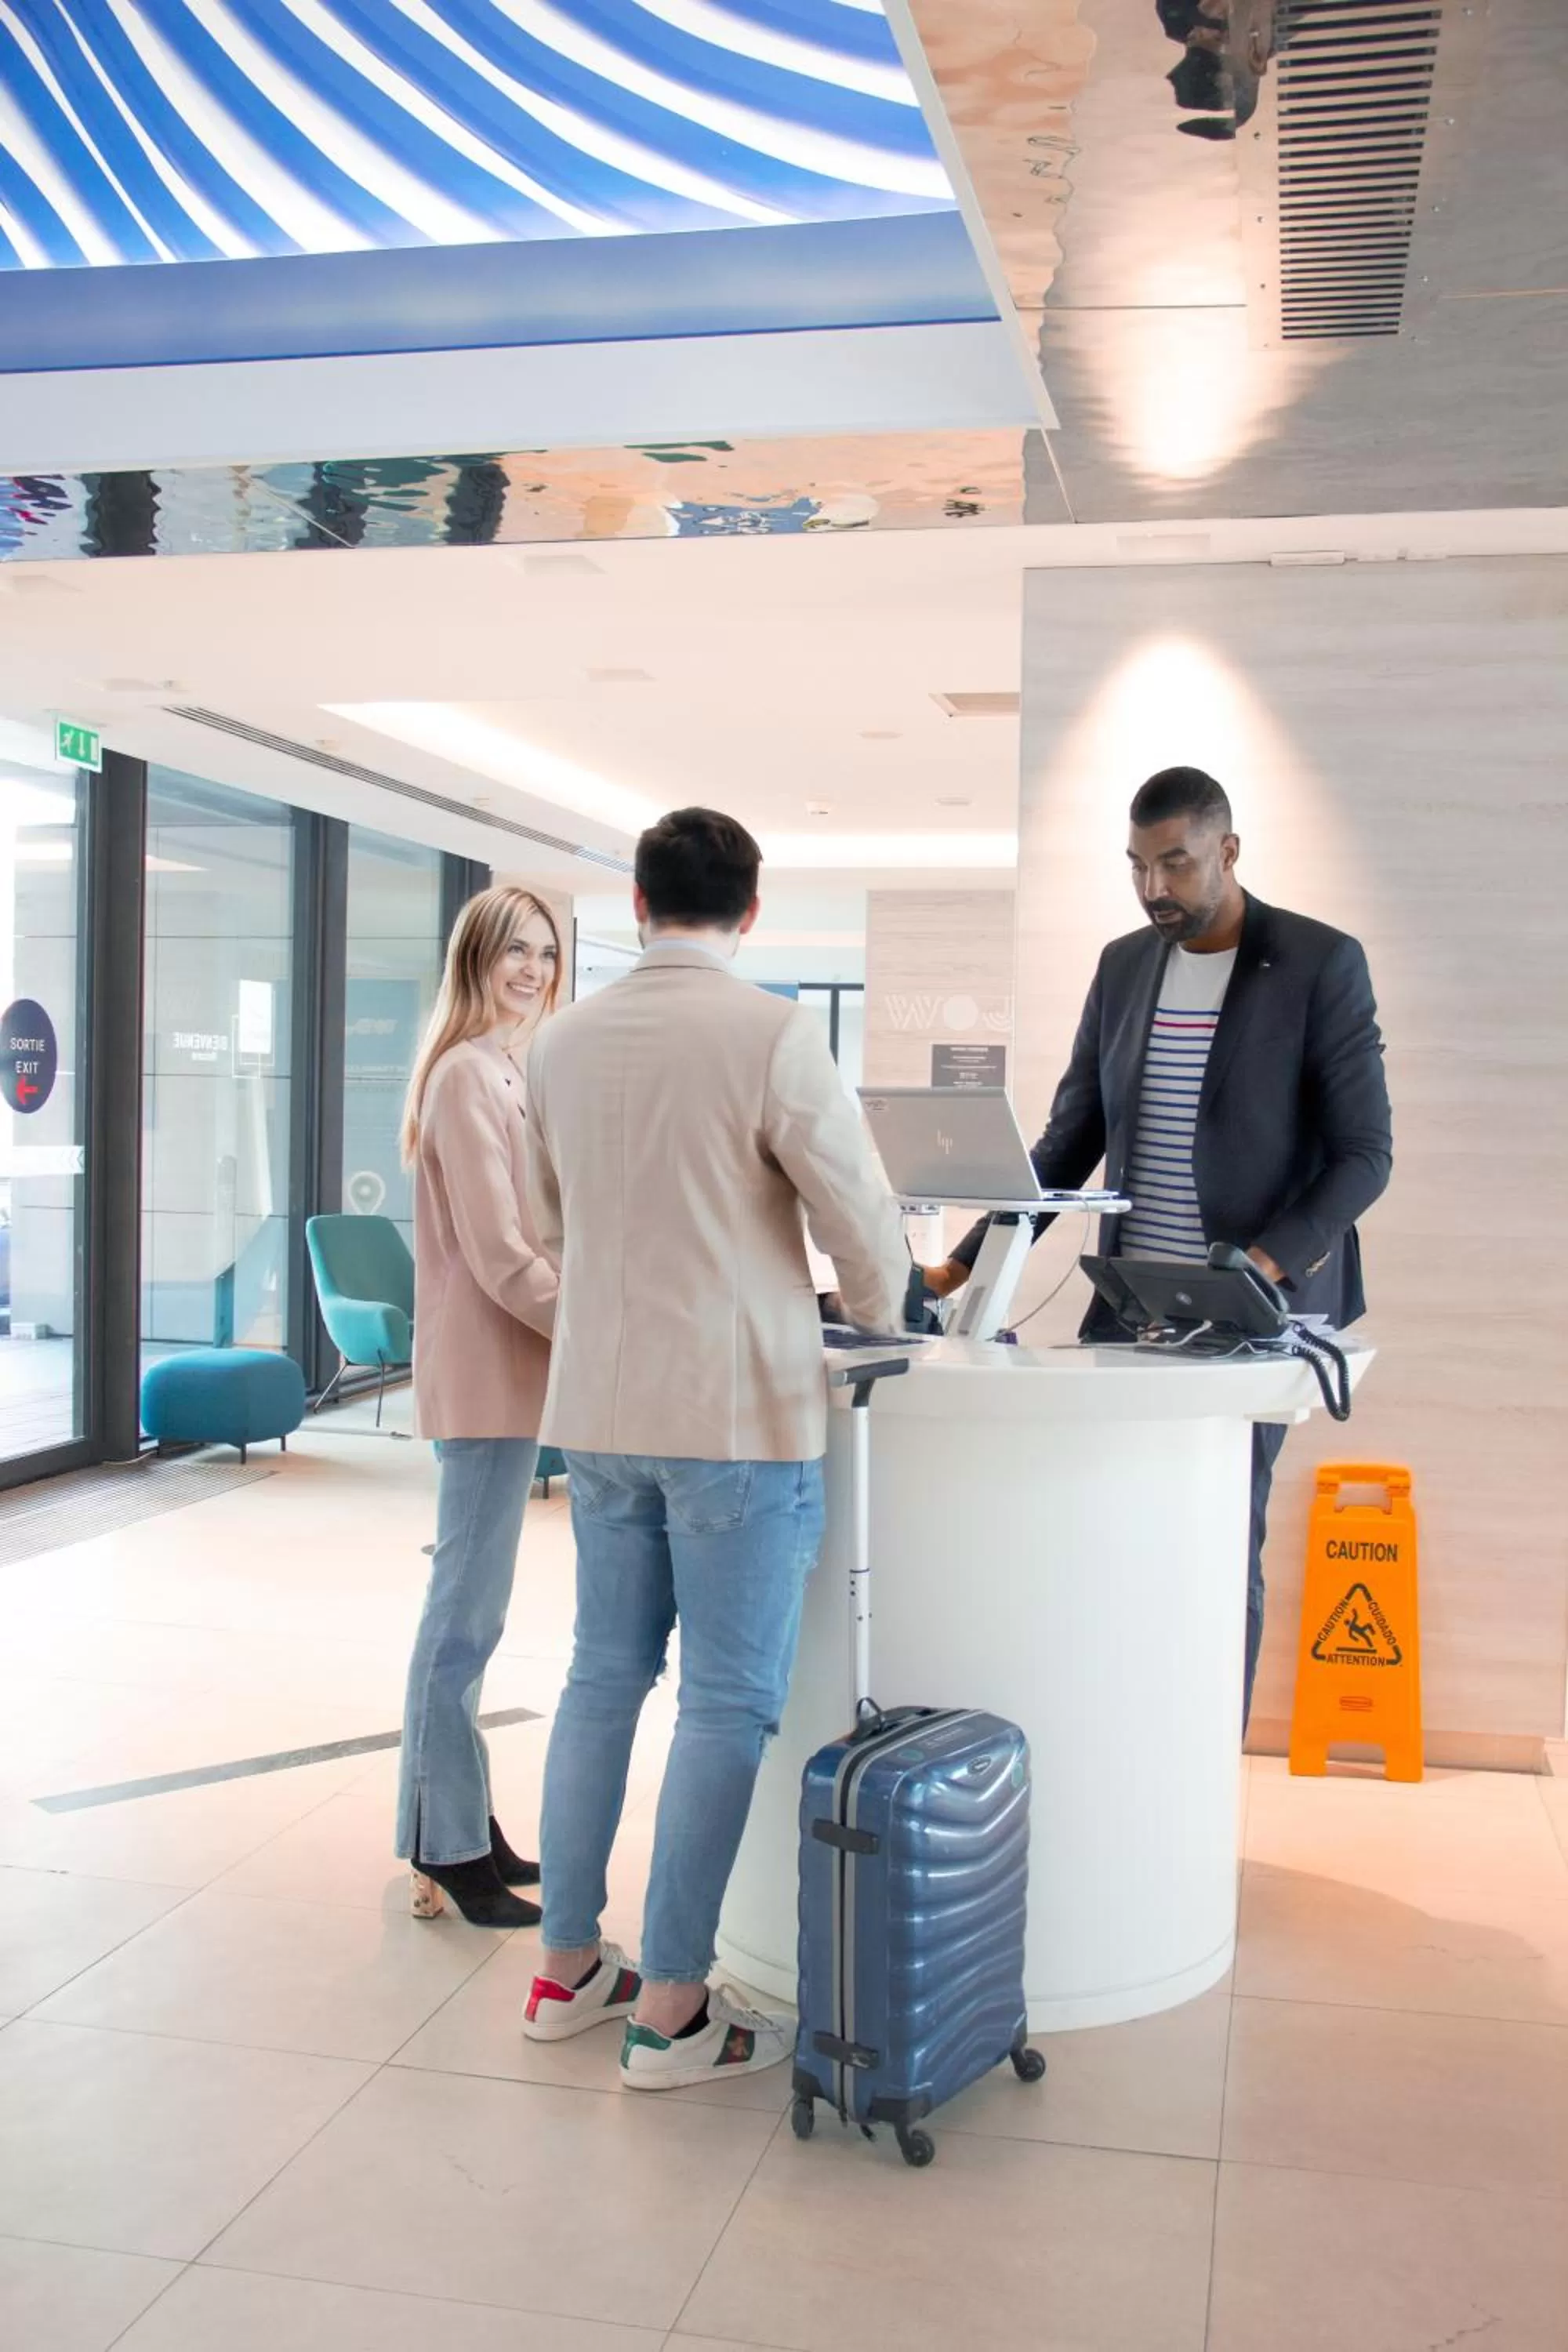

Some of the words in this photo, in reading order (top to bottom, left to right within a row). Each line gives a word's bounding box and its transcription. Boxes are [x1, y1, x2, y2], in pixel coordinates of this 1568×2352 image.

[9, 1037, 45, 1051] SORTIE
[15, 1061, 39, 1074] EXIT
[937, 1129, 953, 1155] hp
[1326, 1540, 1398, 1562] CAUTION
[1317, 1599, 1348, 1642] CAUTION
[1368, 1601, 1397, 1645] CUIDADO
[1326, 1653, 1385, 1668] ATTENTION
